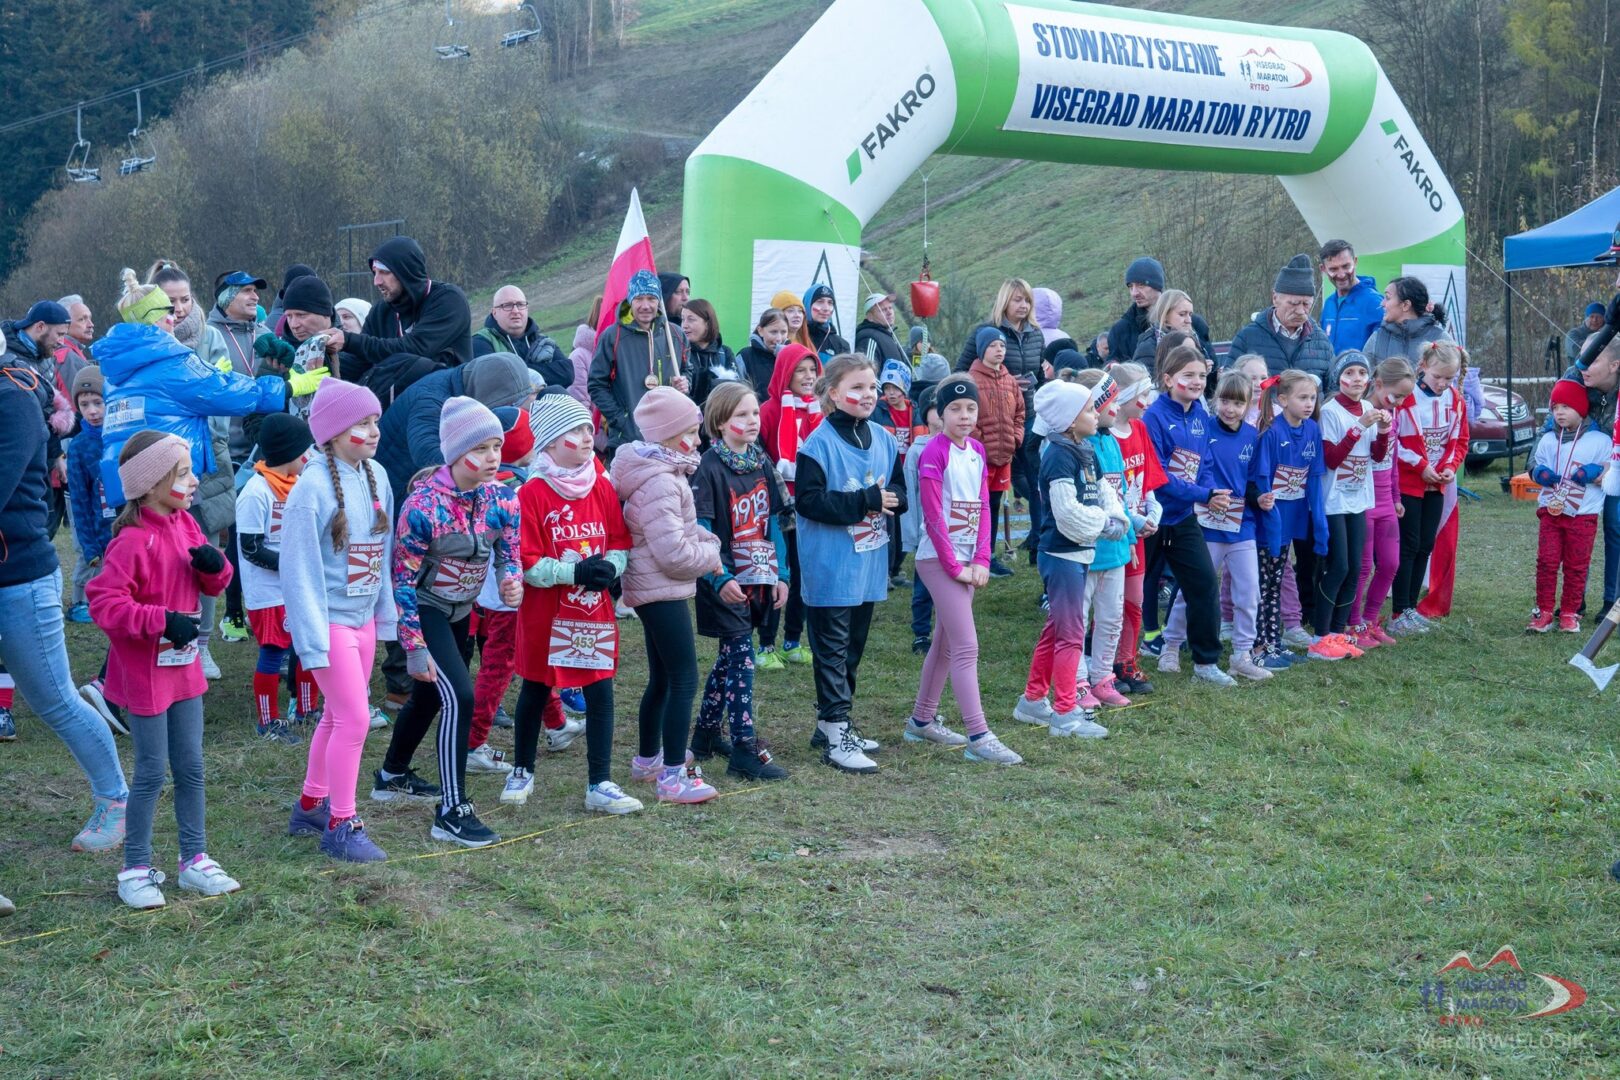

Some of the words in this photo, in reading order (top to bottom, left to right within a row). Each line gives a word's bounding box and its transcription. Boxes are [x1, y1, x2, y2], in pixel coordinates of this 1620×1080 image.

[1032, 22, 1227, 77] STOWARZYSZENIE
[1255, 60, 1285, 71] VISEGRAD
[1249, 83, 1270, 91] RYTRO
[1256, 72, 1289, 83] MARATON
[861, 73, 936, 160] FAKRO
[1030, 83, 1140, 128] VISEGRAD
[1138, 94, 1250, 136] MARATON
[1244, 105, 1312, 141] RYTRO
[1393, 134, 1443, 213] FAKRO
[1094, 389, 1112, 410] BIEG
[732, 489, 769, 527] 1918
[552, 521, 606, 541] POLSKA
[753, 554, 769, 566] 321
[574, 636, 594, 649] 453
